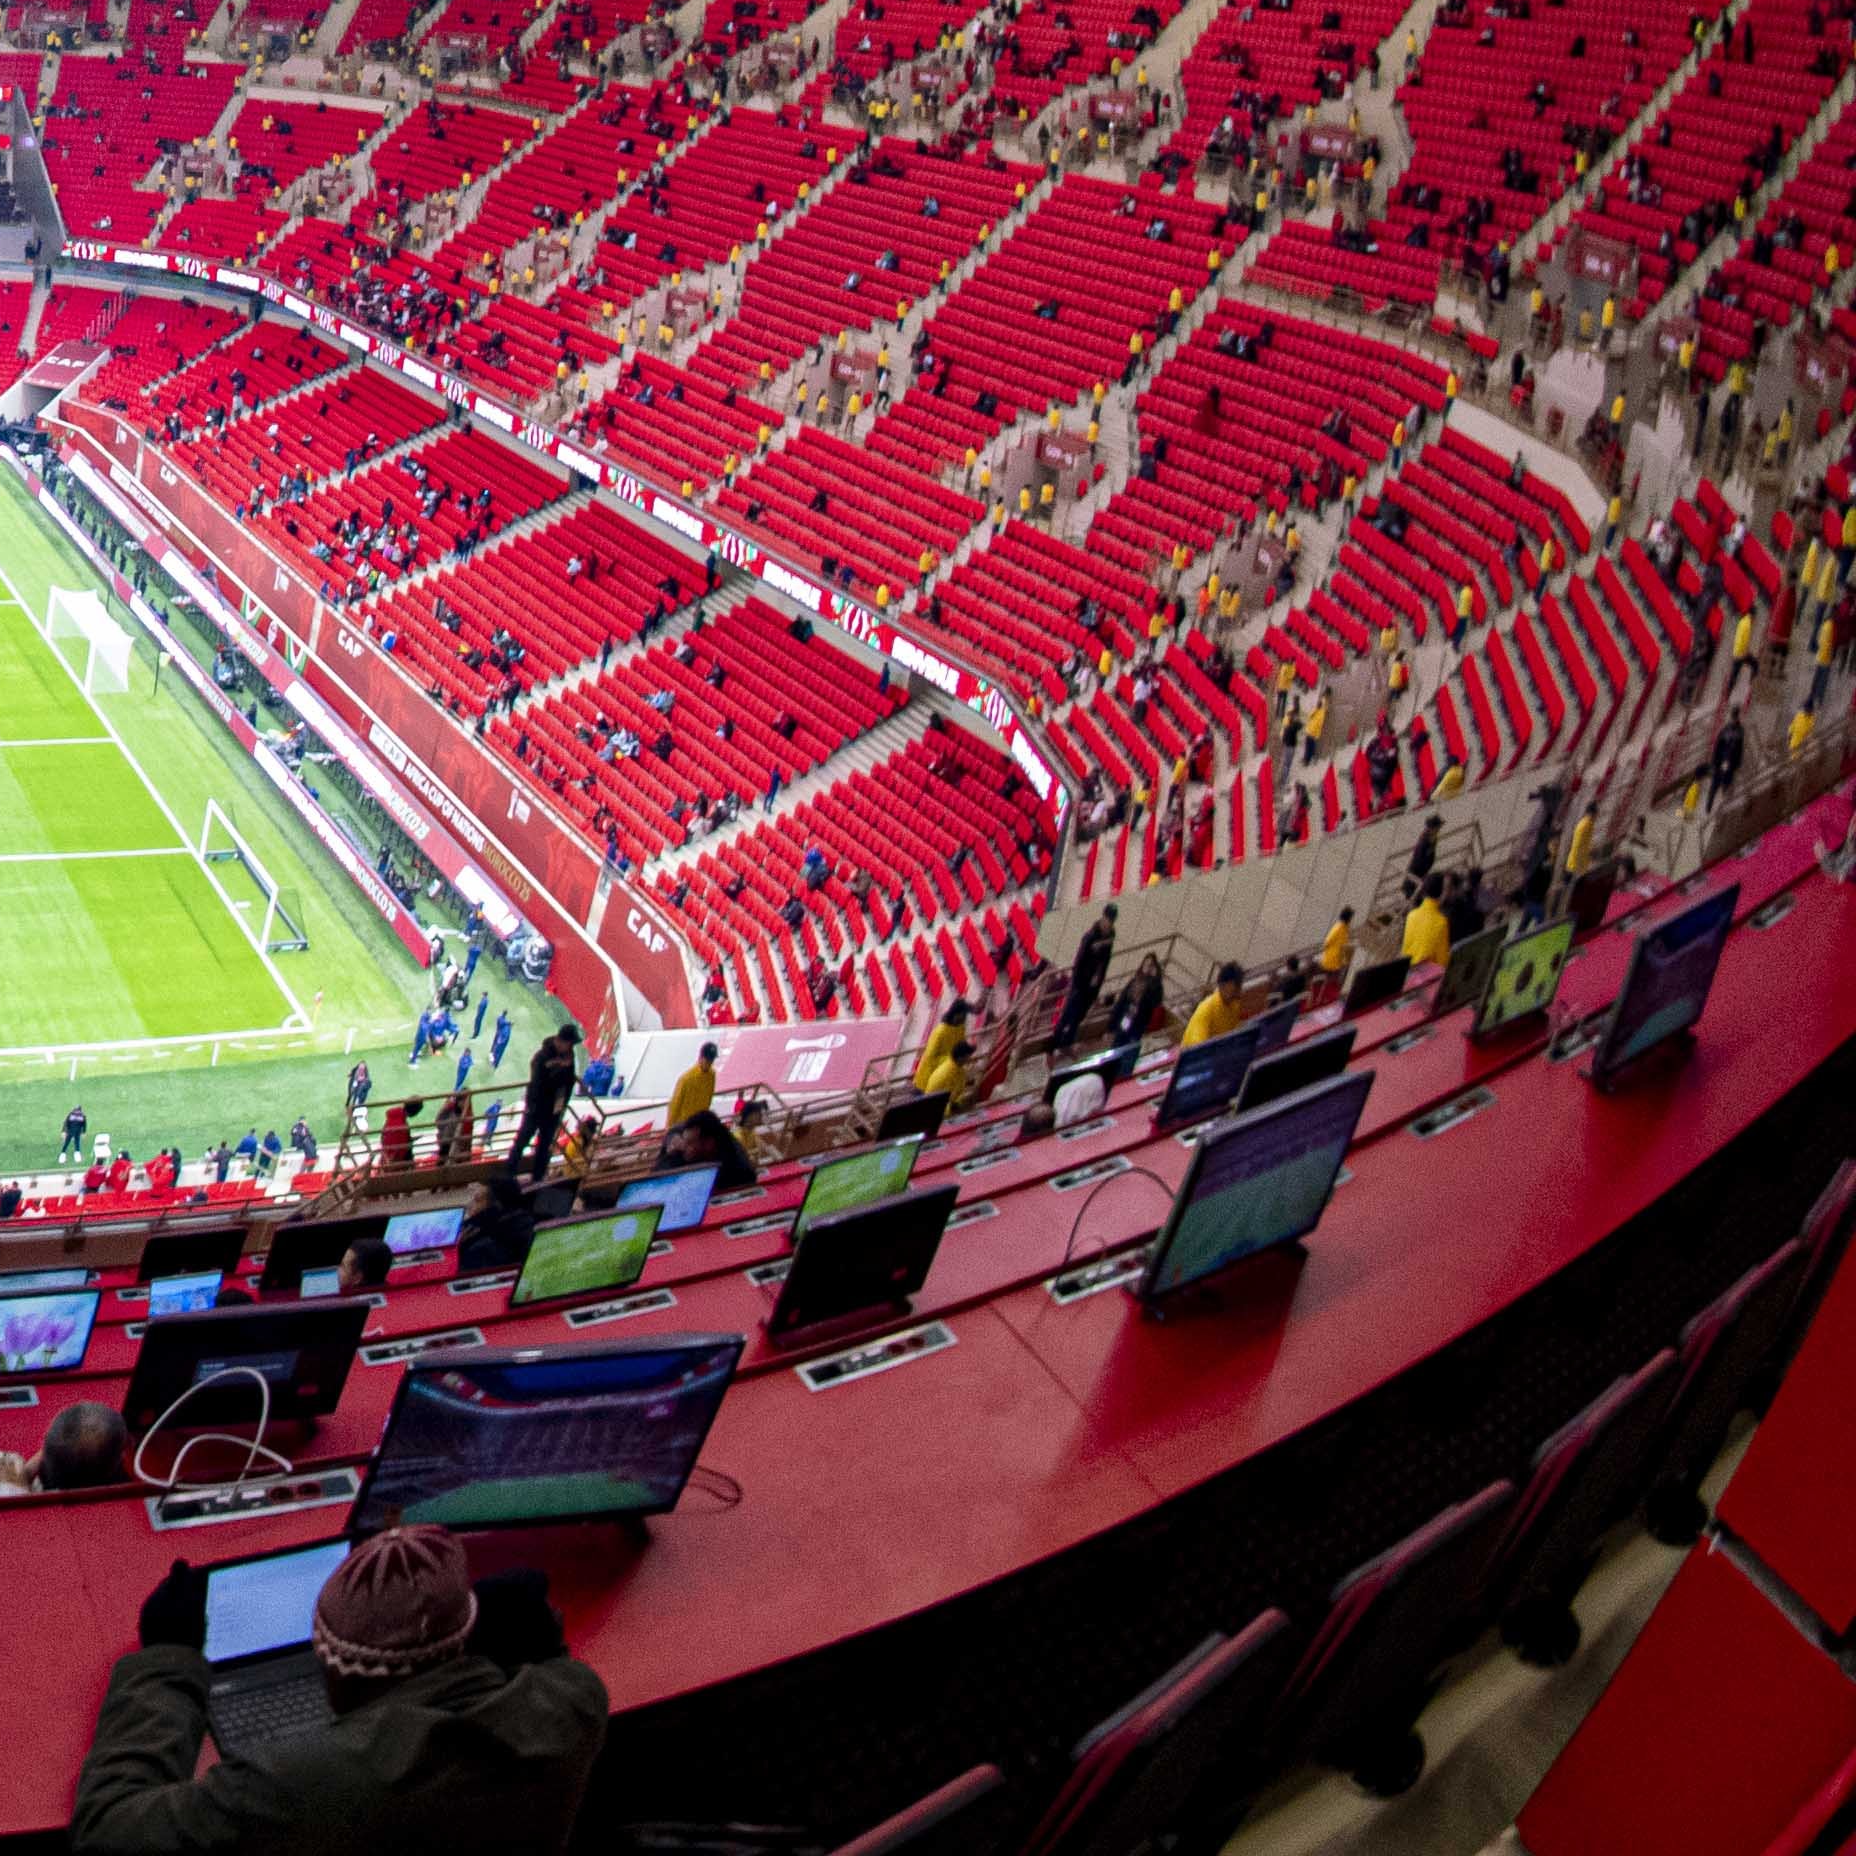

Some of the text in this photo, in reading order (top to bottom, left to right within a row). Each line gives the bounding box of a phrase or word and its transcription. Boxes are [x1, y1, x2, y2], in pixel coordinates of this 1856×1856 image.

[45, 354, 90, 369] CAF
[337, 629, 363, 658] CAF
[626, 908, 669, 954] CAF
